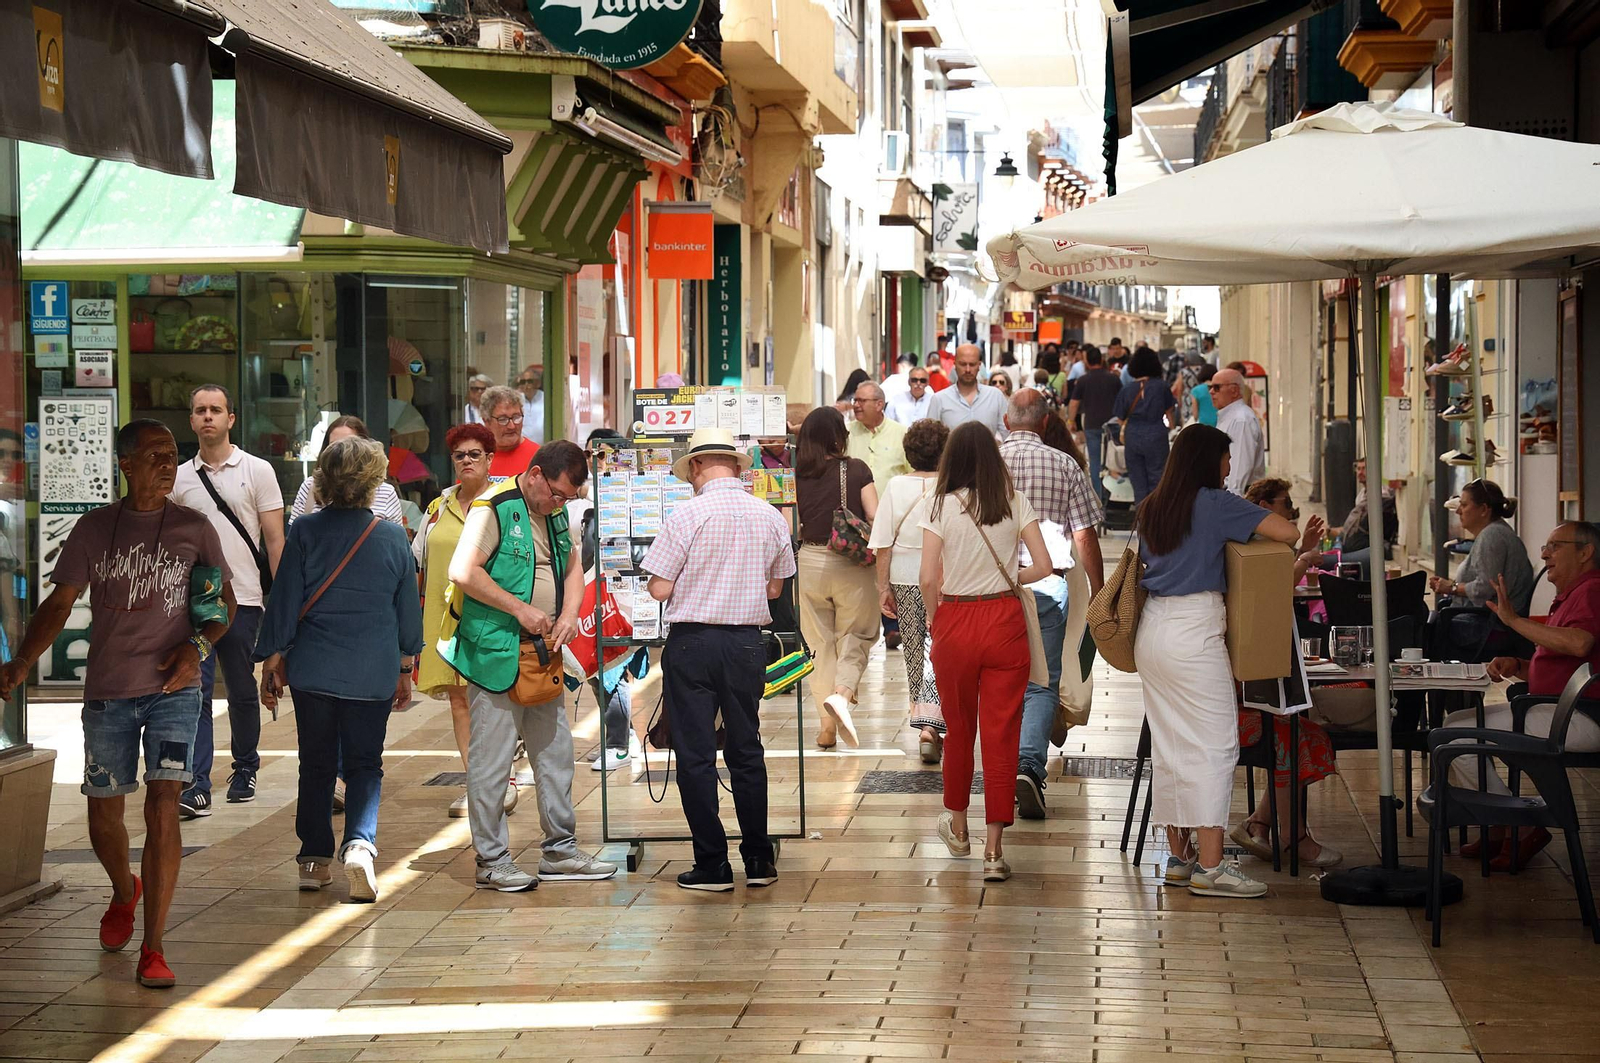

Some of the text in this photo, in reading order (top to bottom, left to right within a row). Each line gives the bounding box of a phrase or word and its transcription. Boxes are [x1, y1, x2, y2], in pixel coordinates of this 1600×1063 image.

[577, 42, 658, 63] Fundada en 1915
[719, 256, 730, 371] Herbolario
[44, 504, 74, 512] Servicio
